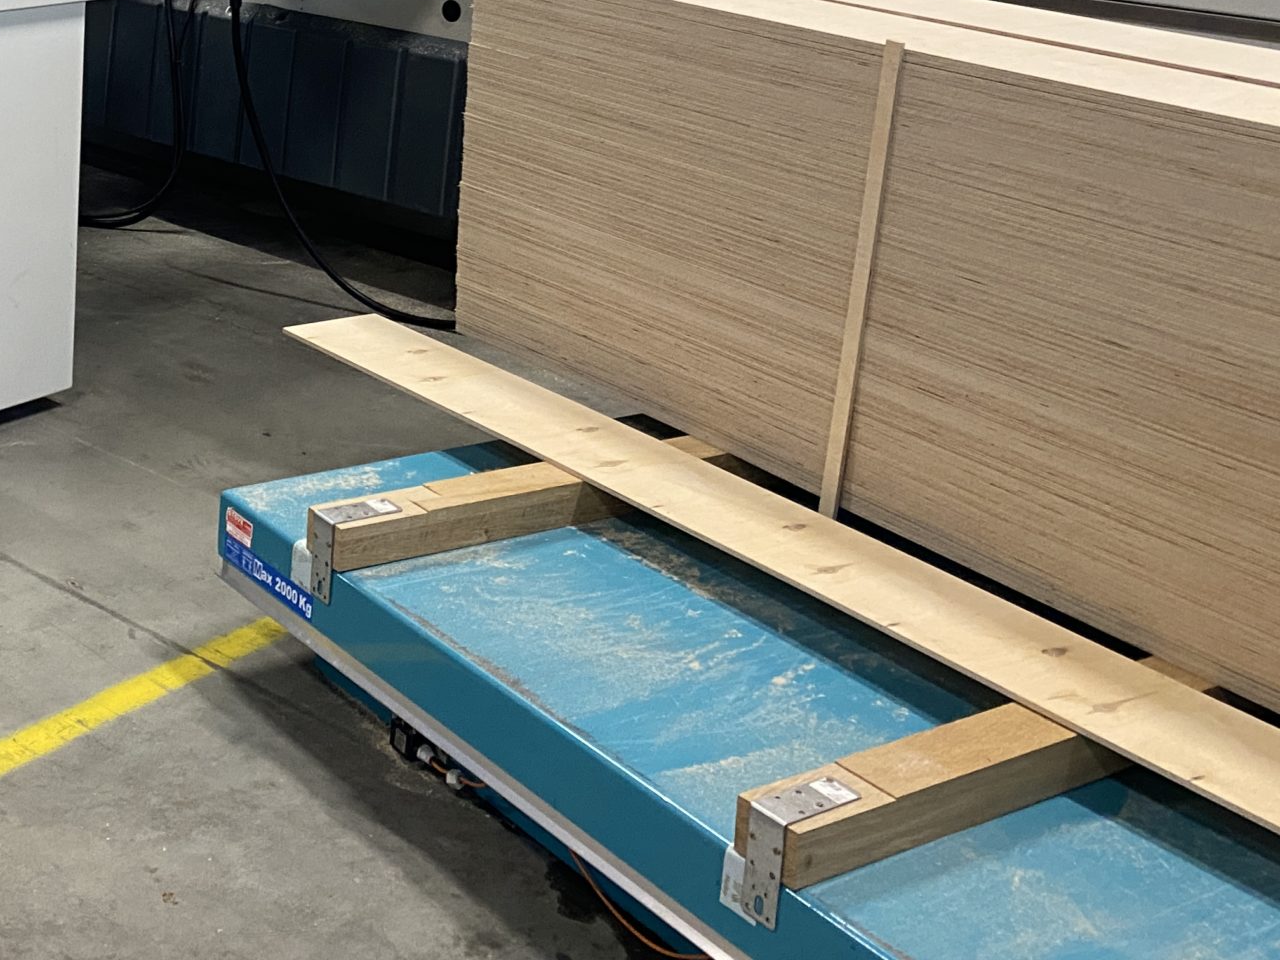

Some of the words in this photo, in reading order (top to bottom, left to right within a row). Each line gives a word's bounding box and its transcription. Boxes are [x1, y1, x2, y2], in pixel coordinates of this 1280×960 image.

[253, 559, 273, 586] Max
[274, 577, 298, 605] 2000
[299, 594, 312, 619] Kg
